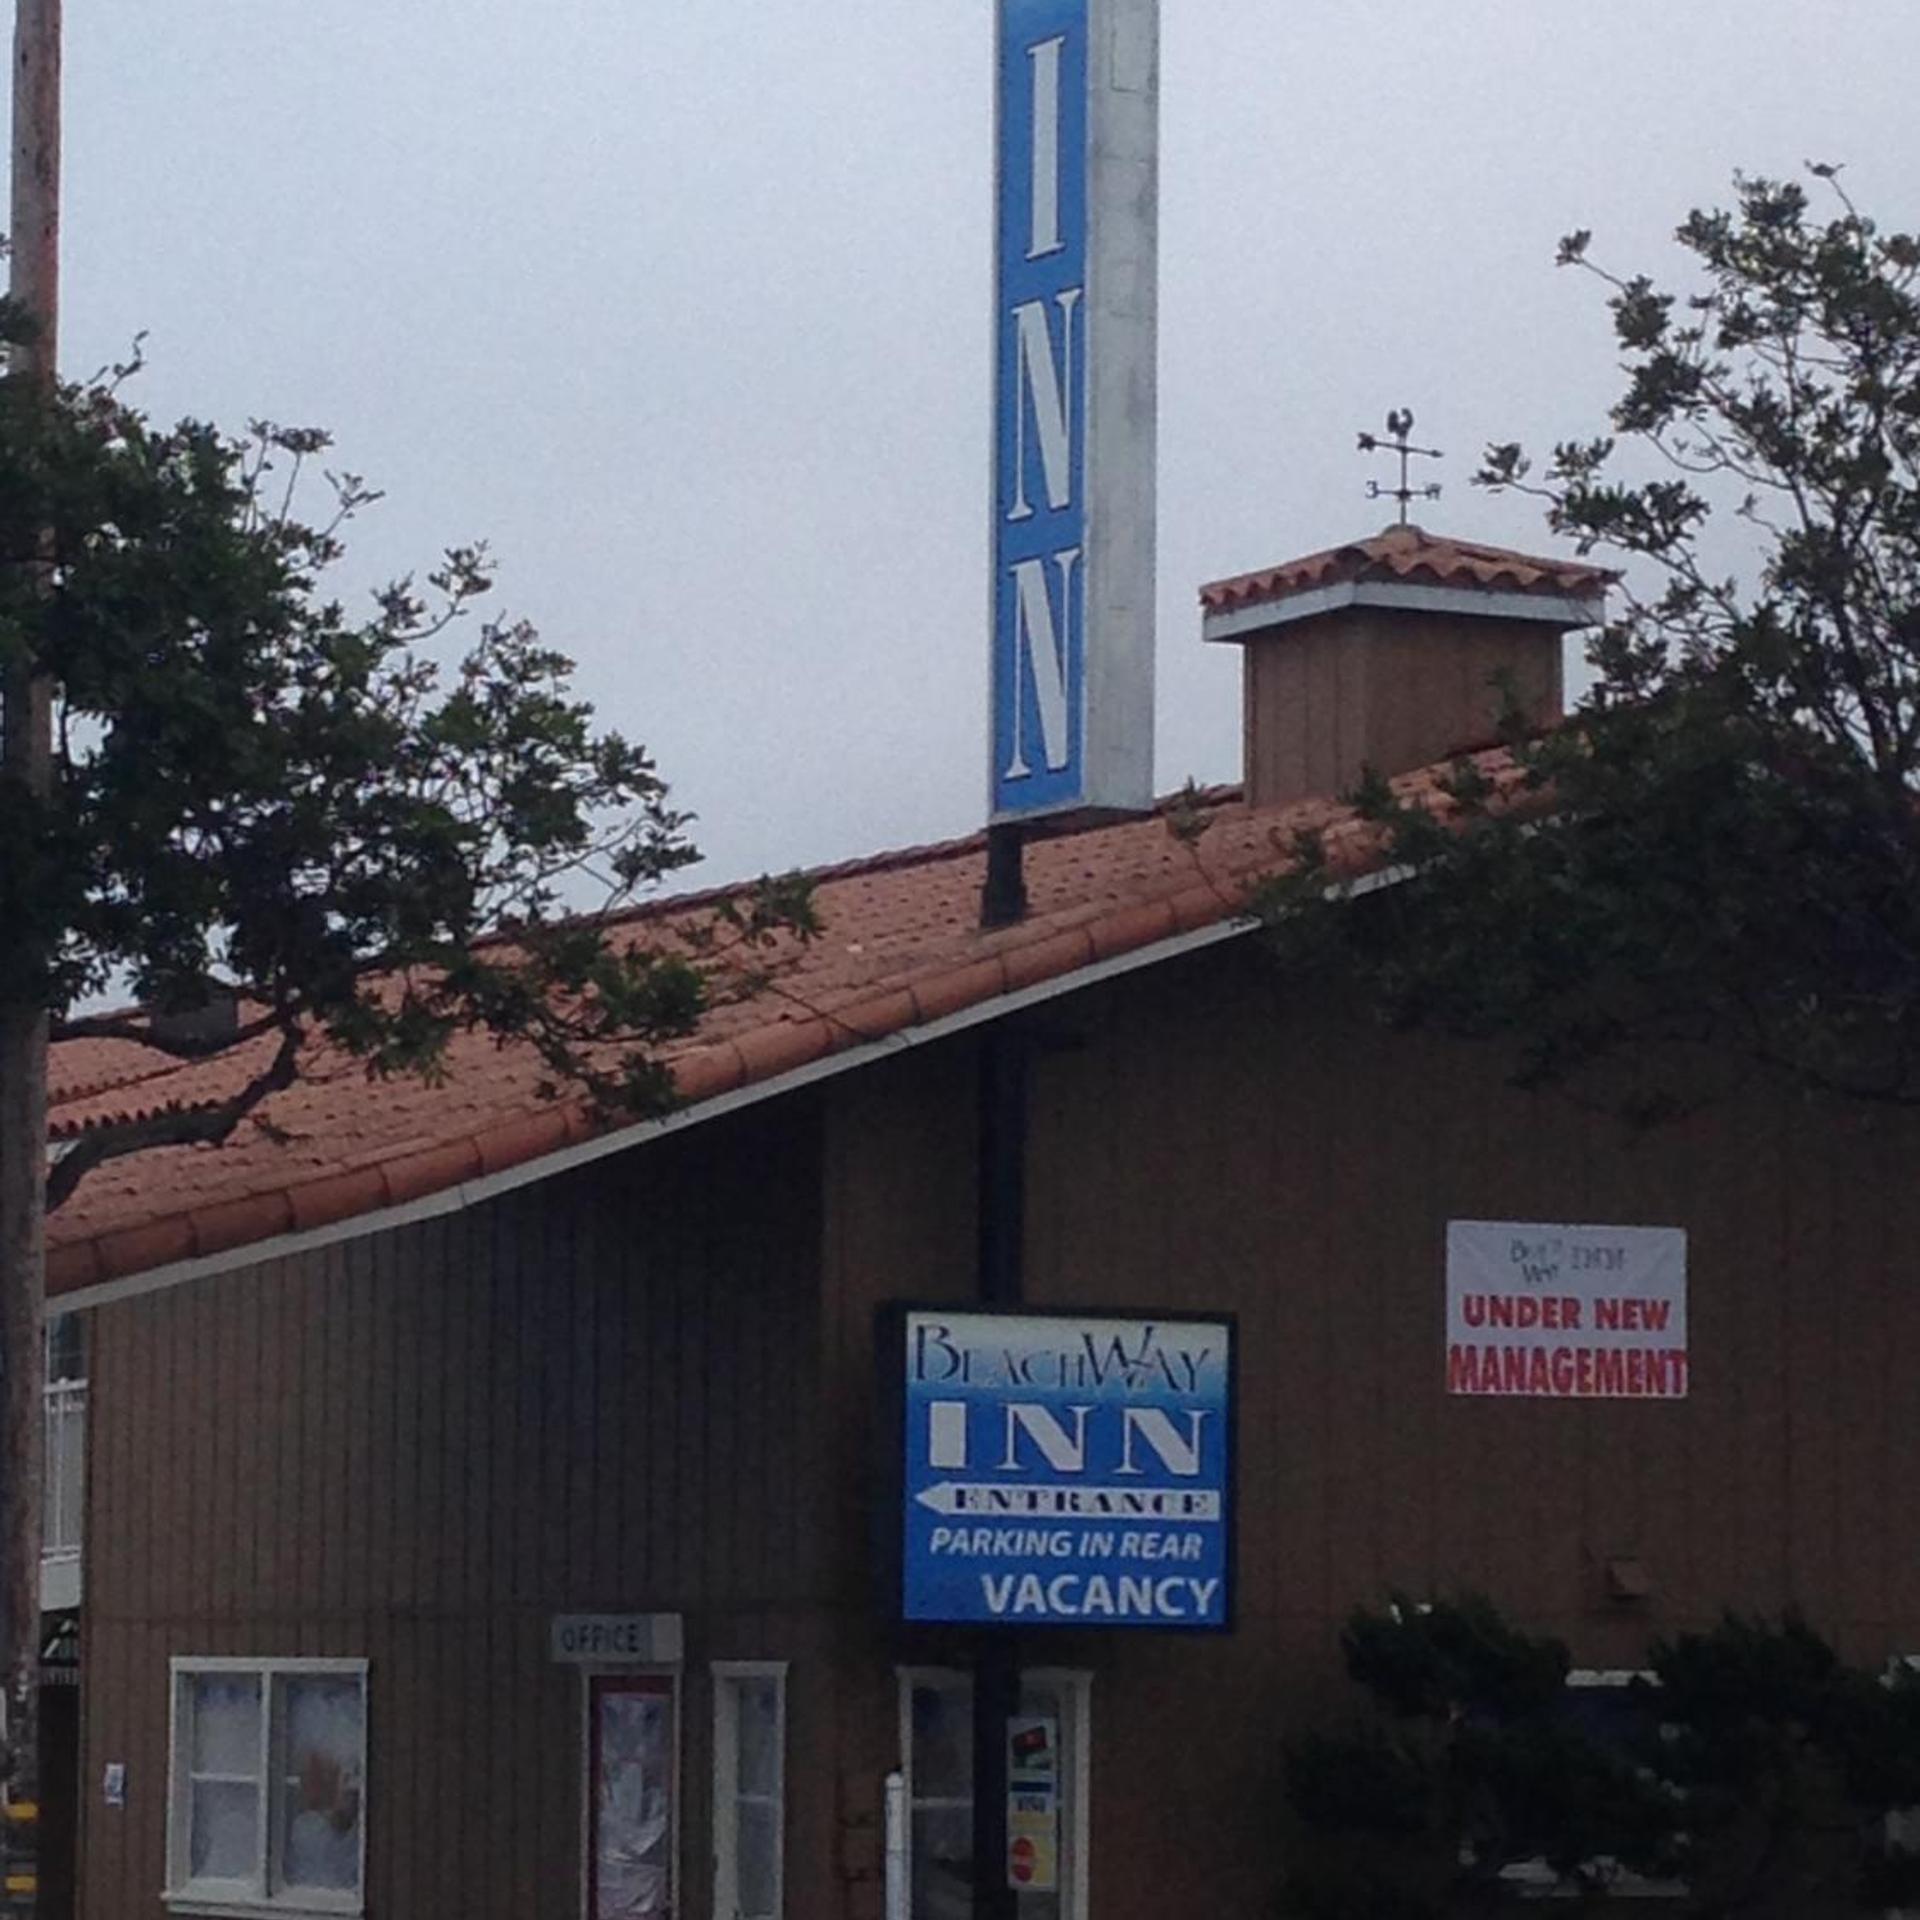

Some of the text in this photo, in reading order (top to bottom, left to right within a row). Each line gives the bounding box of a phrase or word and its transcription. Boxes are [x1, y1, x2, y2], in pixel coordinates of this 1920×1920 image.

[1004, 35, 1084, 781] INN
[1463, 1294, 1671, 1331] UNDER NEW
[1449, 1344, 1688, 1395] MANAGEMENT
[929, 1401, 1213, 1476] INN
[954, 1488, 1209, 1515] ENTRANCE
[930, 1527, 1204, 1560] PARKING IN REAR
[981, 1573, 1219, 1617] VACANCY
[561, 1622, 640, 1653] OFFICE
